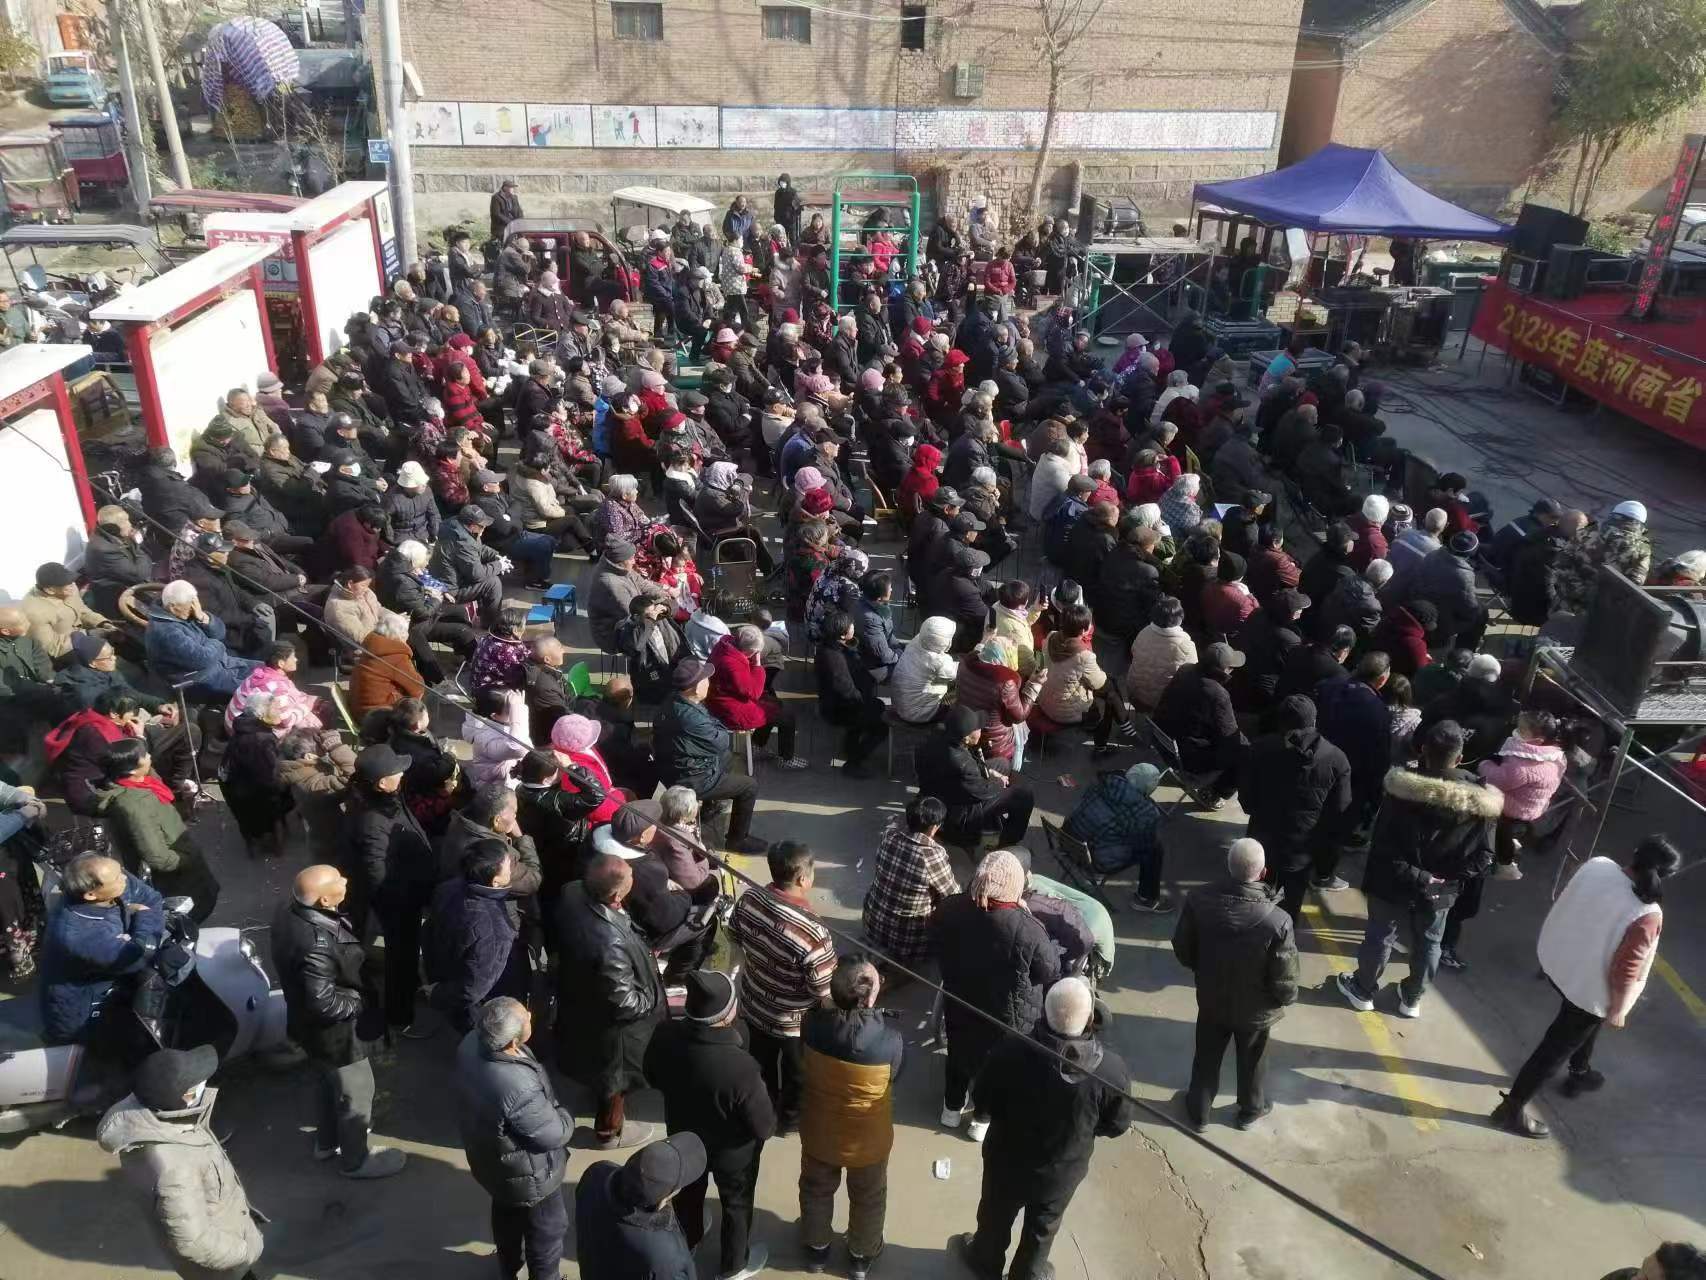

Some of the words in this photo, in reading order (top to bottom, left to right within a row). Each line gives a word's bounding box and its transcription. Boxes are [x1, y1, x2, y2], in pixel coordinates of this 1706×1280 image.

[1497, 303, 1701, 423] 2023年度河南省
